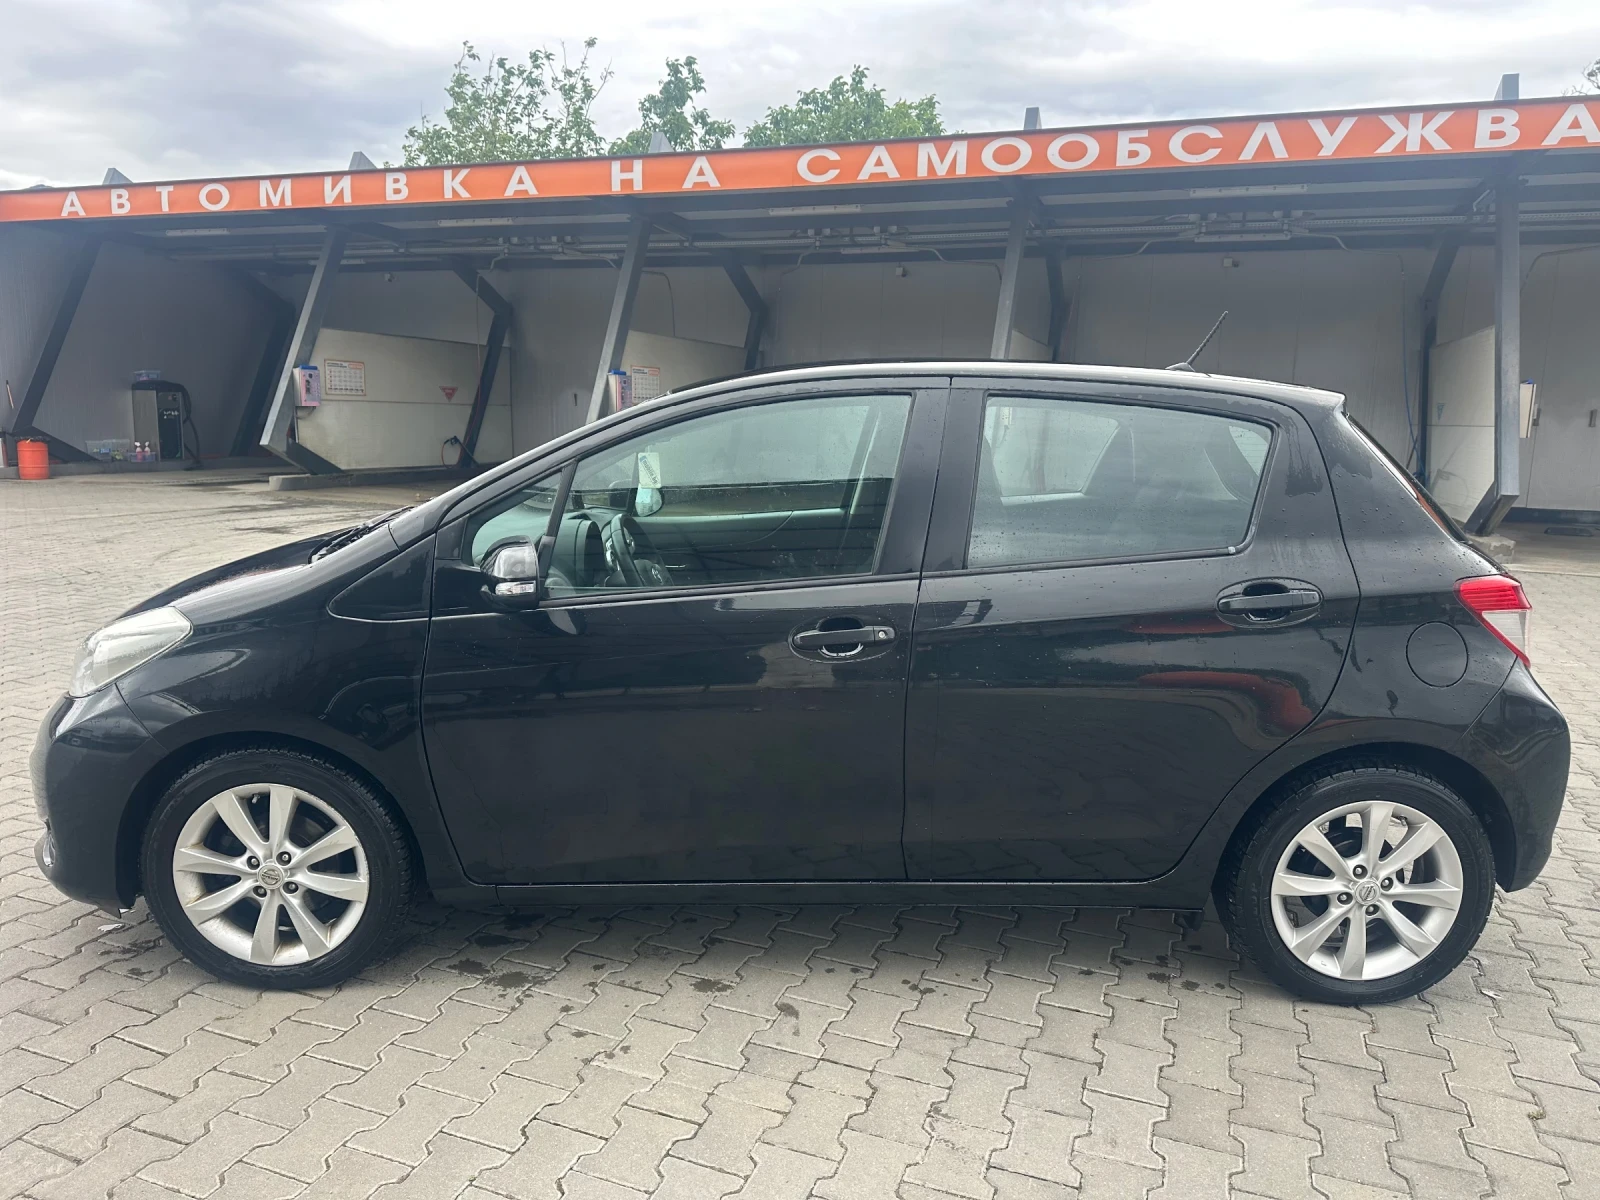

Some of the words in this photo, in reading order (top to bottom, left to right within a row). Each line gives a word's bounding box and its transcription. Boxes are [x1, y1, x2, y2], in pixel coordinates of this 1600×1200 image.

[61, 166, 538, 217] АВТОМИВКА
[611, 156, 721, 191] НА
[796, 103, 1600, 183] САМООБСЛУЖВА
